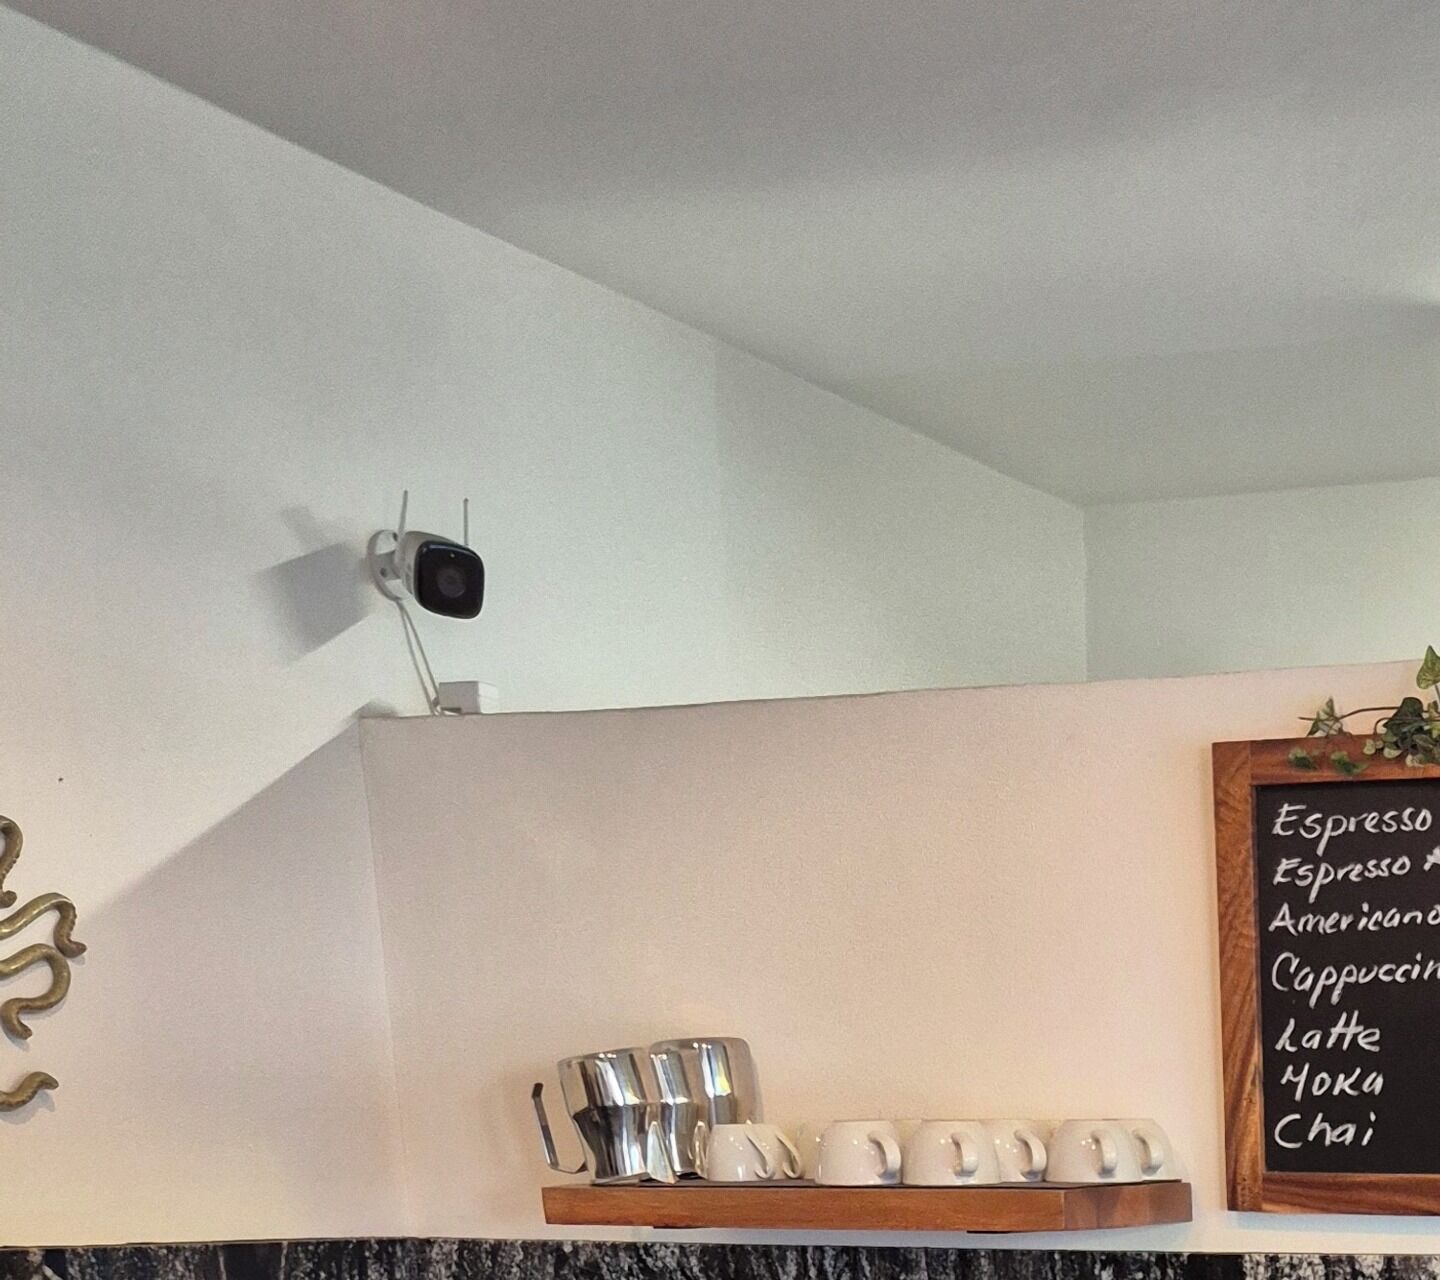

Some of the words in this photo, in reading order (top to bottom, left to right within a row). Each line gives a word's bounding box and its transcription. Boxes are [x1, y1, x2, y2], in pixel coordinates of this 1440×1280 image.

[1272, 803, 1432, 855] Espresso
[1273, 855, 1410, 903] Espresso
[1275, 1010, 1381, 1052] Latte
[1274, 1112, 1376, 1149] Chai
